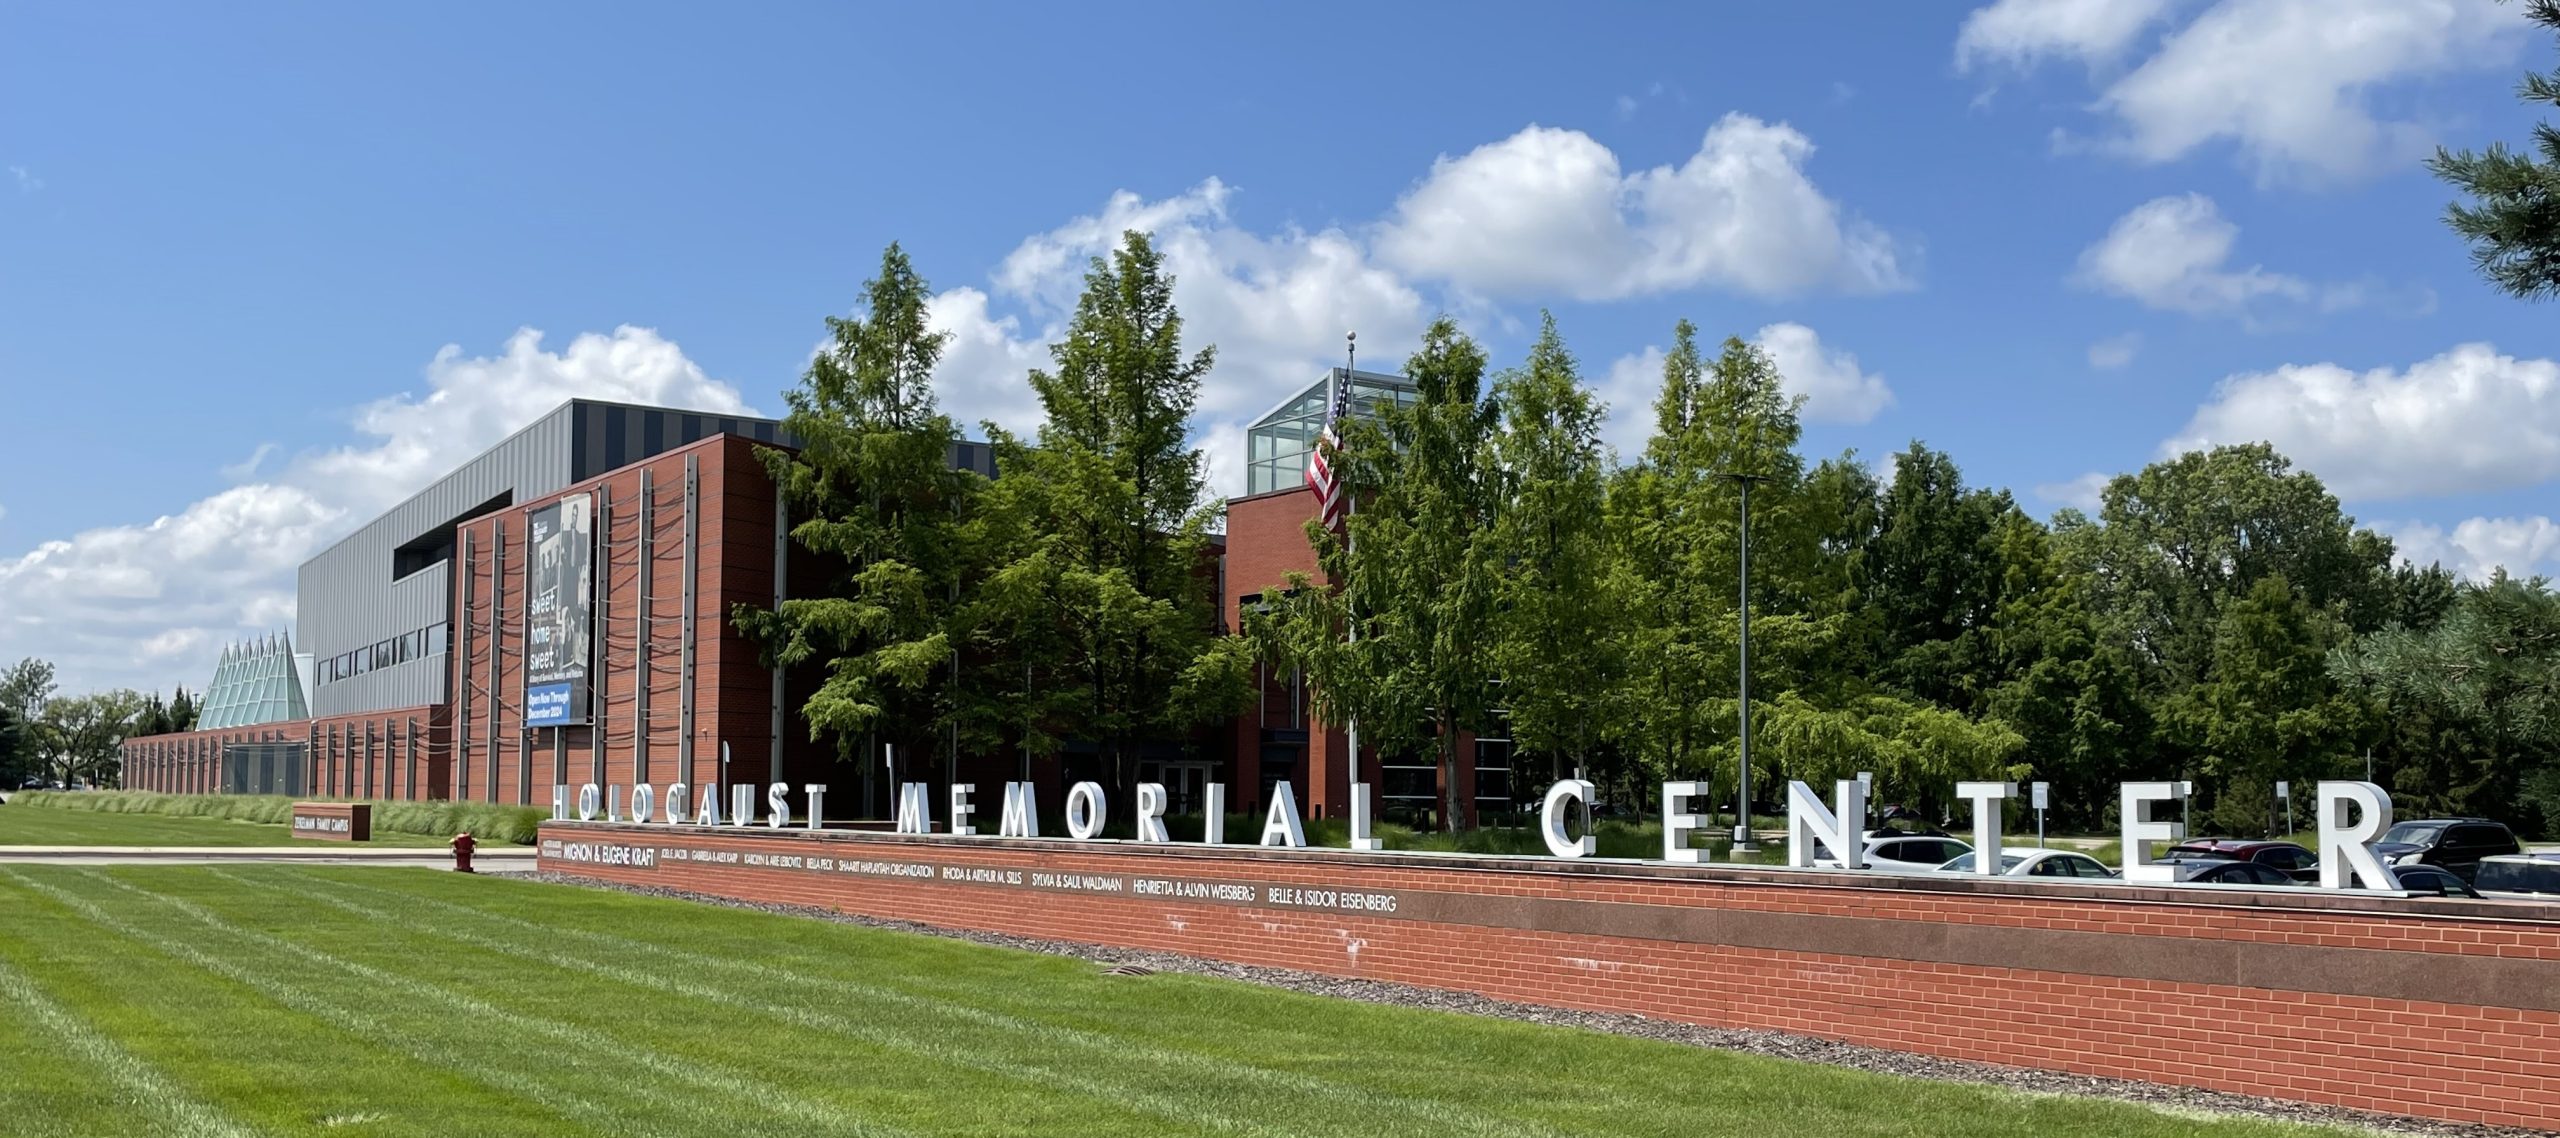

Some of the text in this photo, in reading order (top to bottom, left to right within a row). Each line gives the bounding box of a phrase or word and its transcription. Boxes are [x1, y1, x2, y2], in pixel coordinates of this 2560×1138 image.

[531, 593, 555, 615] sweet
[531, 623, 550, 644] home
[530, 647, 554, 670] sweet
[552, 780, 2404, 891] HOLOCAUST MEMORIAL CENTER
[564, 843, 592, 862] MIGNON
[594, 845, 600, 862] &
[602, 846, 630, 864] EUGENE
[632, 848, 654, 866] KRAFT
[806, 858, 834, 870] BELLA PECK
[838, 860, 860, 872] SHAARIT
[890, 864, 934, 878] ORGANIZATION
[942, 867, 965, 880] RHODA
[966, 868, 971, 881] &
[972, 869, 996, 883] ARTHUR
[1007, 871, 1022, 884] SILLS
[1032, 873, 1122, 891] SYLVIA & SAUL WALDMAN
[1134, 879, 1255, 901] HENRIETTA & ALVIN WEISBERG
[1268, 888, 1396, 912] BELLE & ISIDOR EISENBERG
